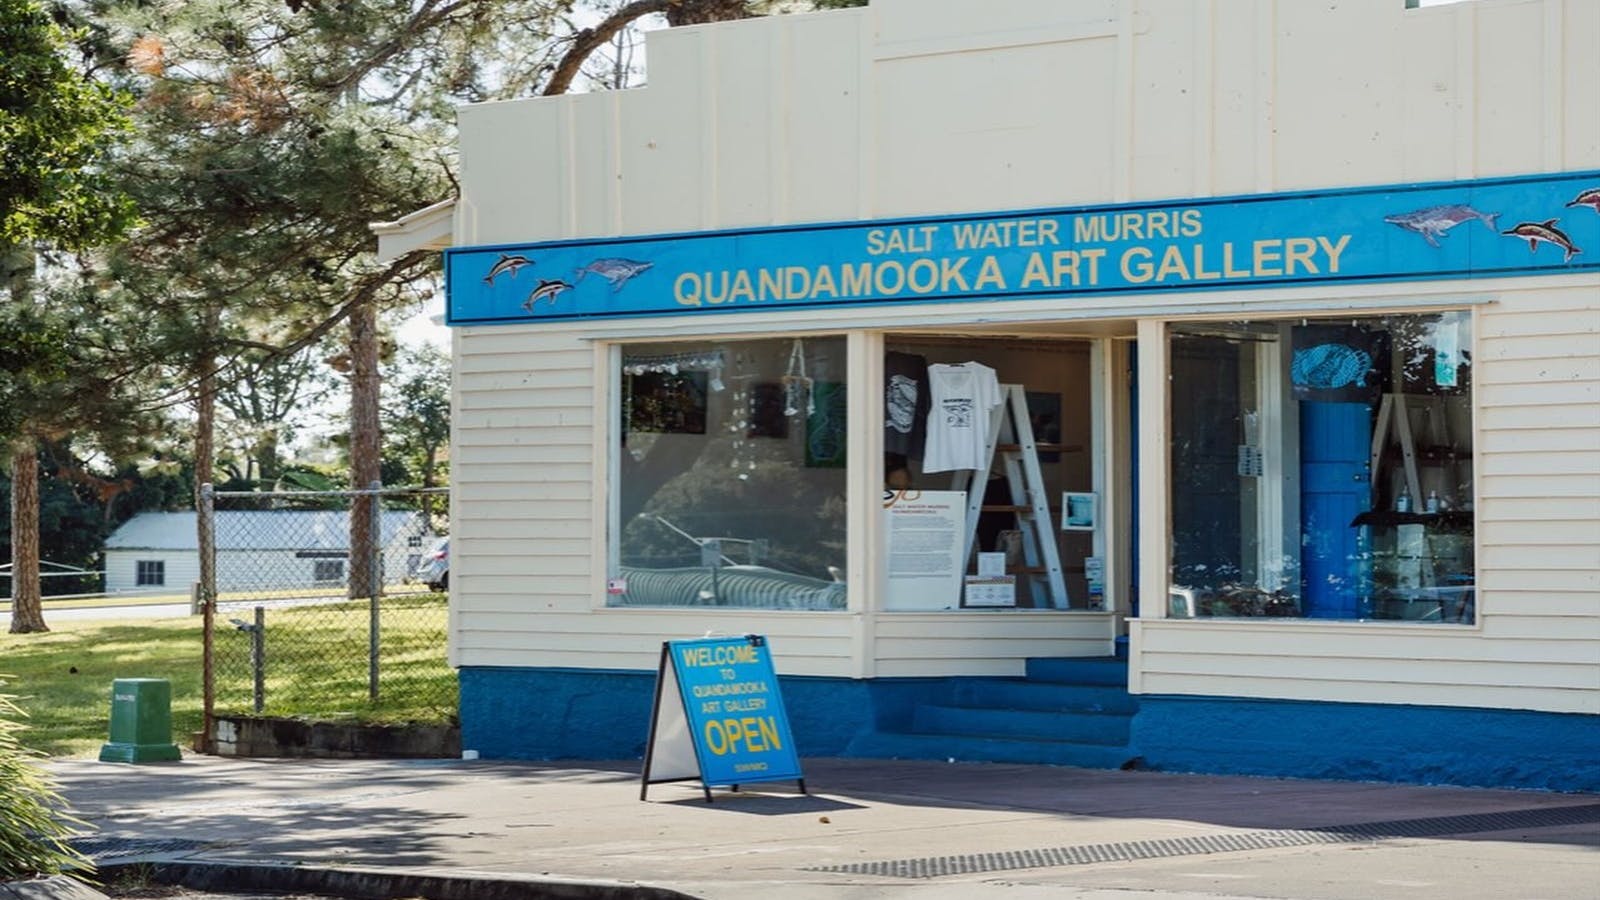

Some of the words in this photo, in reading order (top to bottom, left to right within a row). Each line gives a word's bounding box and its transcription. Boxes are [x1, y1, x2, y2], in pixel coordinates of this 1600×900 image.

[866, 226, 938, 255] SALT
[953, 219, 1060, 250] WATER
[1074, 209, 1203, 243] MURRIS
[673, 256, 1007, 306] QUANDAMOOKA
[1021, 249, 1106, 289] ART
[1120, 235, 1353, 283] GALLERY
[682, 645, 759, 667] WELCOME
[719, 668, 736, 680] TO
[702, 701, 720, 713] ART
[724, 698, 766, 712] GALLERY
[705, 716, 782, 755] OPEN
